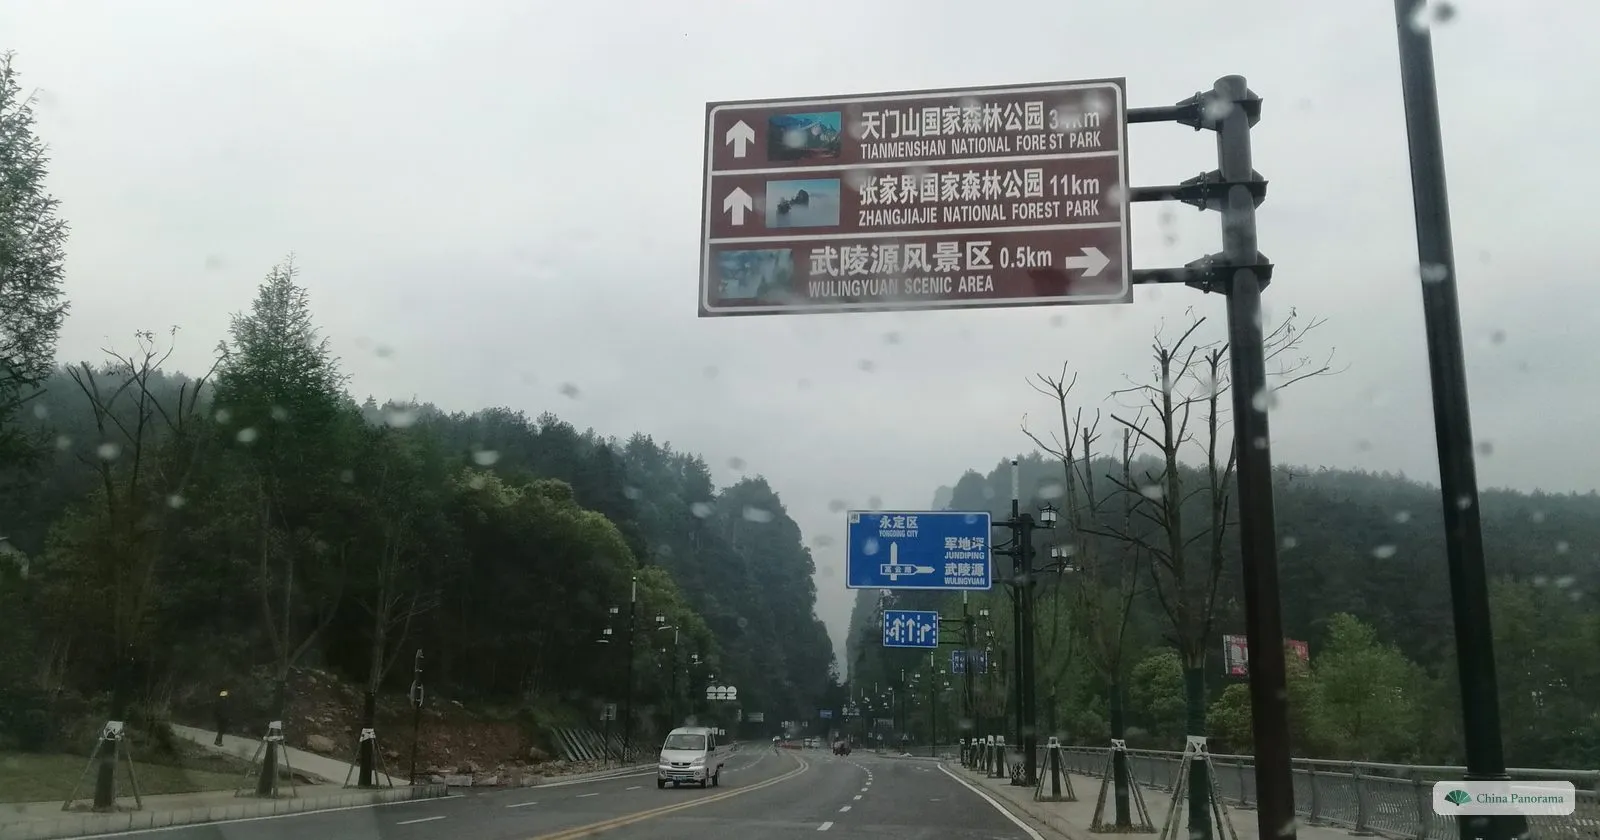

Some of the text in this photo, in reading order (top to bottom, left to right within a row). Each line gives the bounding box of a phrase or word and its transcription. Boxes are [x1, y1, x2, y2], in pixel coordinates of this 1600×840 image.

[861, 101, 1043, 140] 天门山国家森林公园
[860, 139, 946, 159] TIANMENSHAN
[951, 136, 1011, 155] NATIONAL
[1070, 131, 1101, 149] PARK
[859, 168, 1100, 206] 张家界国家森林公园 11km
[859, 199, 1099, 227] ZHANGJIAJIE NATIONAL FOREST PARK
[809, 241, 1052, 277] 武陵源风景区 0.5km
[808, 275, 994, 298] WULINGYUAN SCENIC AREA
[879, 515, 919, 529] 永定区
[906, 530, 919, 538] CITY
[944, 536, 985, 551] 军地坪
[944, 551, 985, 560] JUNDIPING
[944, 562, 985, 577] 武陵源
[944, 576, 986, 585] WULINGYUAN
